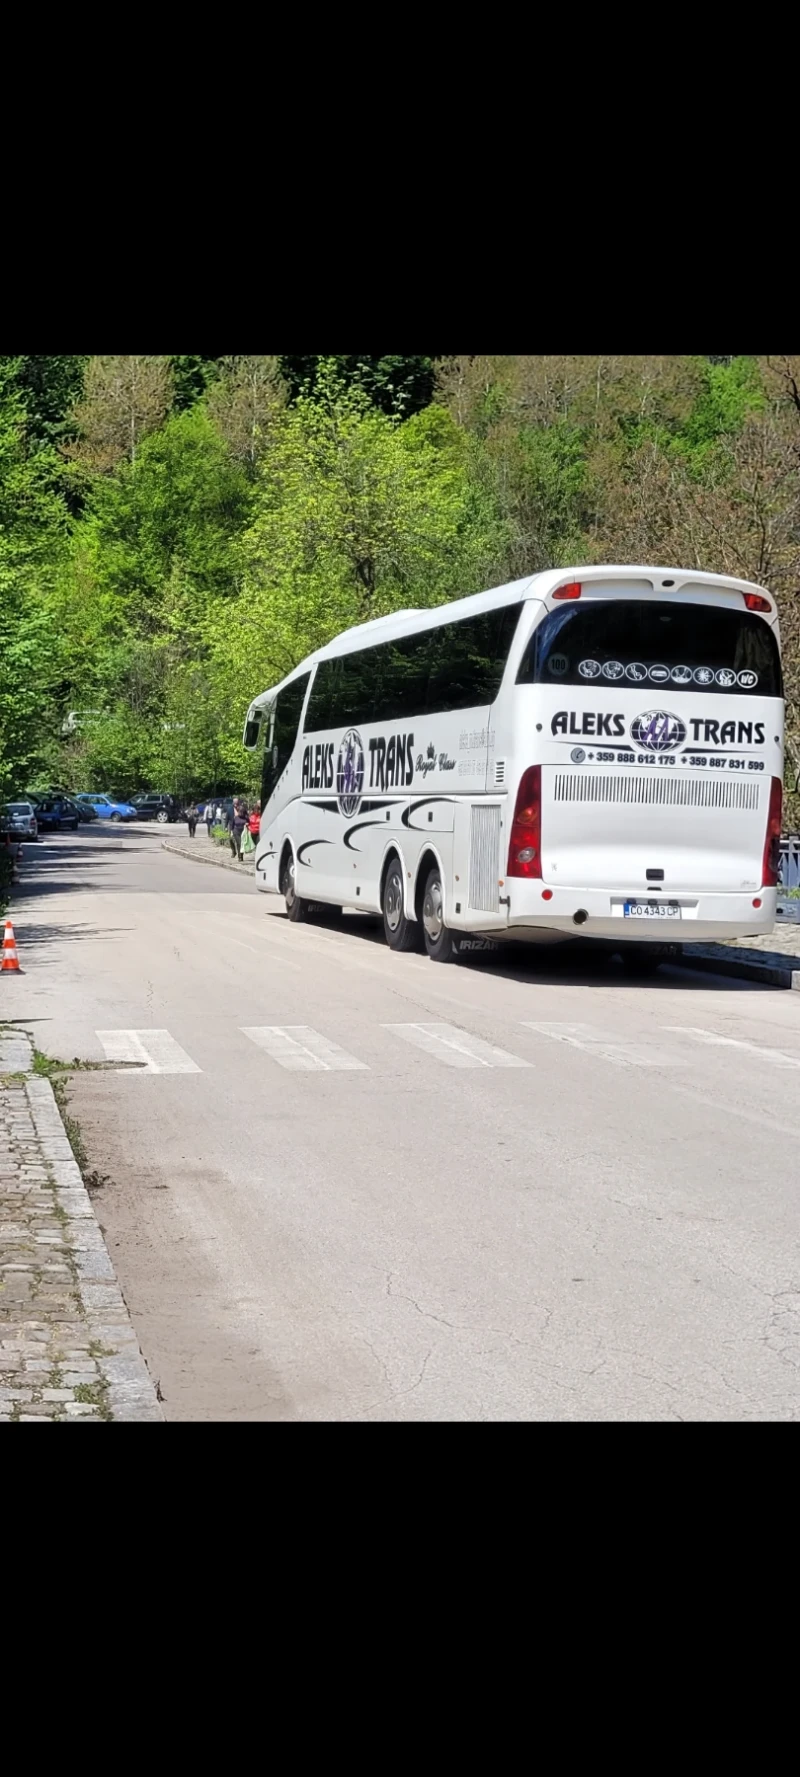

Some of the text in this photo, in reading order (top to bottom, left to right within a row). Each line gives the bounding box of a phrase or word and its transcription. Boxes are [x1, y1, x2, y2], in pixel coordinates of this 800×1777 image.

[551, 658, 566, 670] 100
[741, 674, 754, 684] WC
[551, 711, 625, 737] ALEKS
[690, 718, 766, 745] TRANS
[302, 744, 334, 792] ALEKS
[369, 734, 414, 792] TRANS
[415, 753, 437, 779] Royal
[597, 751, 614, 762] 359
[617, 752, 635, 763] 888
[638, 753, 655, 764] 612
[658, 755, 676, 765] 175
[689, 756, 707, 767] 359
[709, 757, 726, 768] 887
[728, 758, 745, 769] 831
[748, 760, 765, 771] 599
[631, 906, 678, 917] CO 4343 CP
